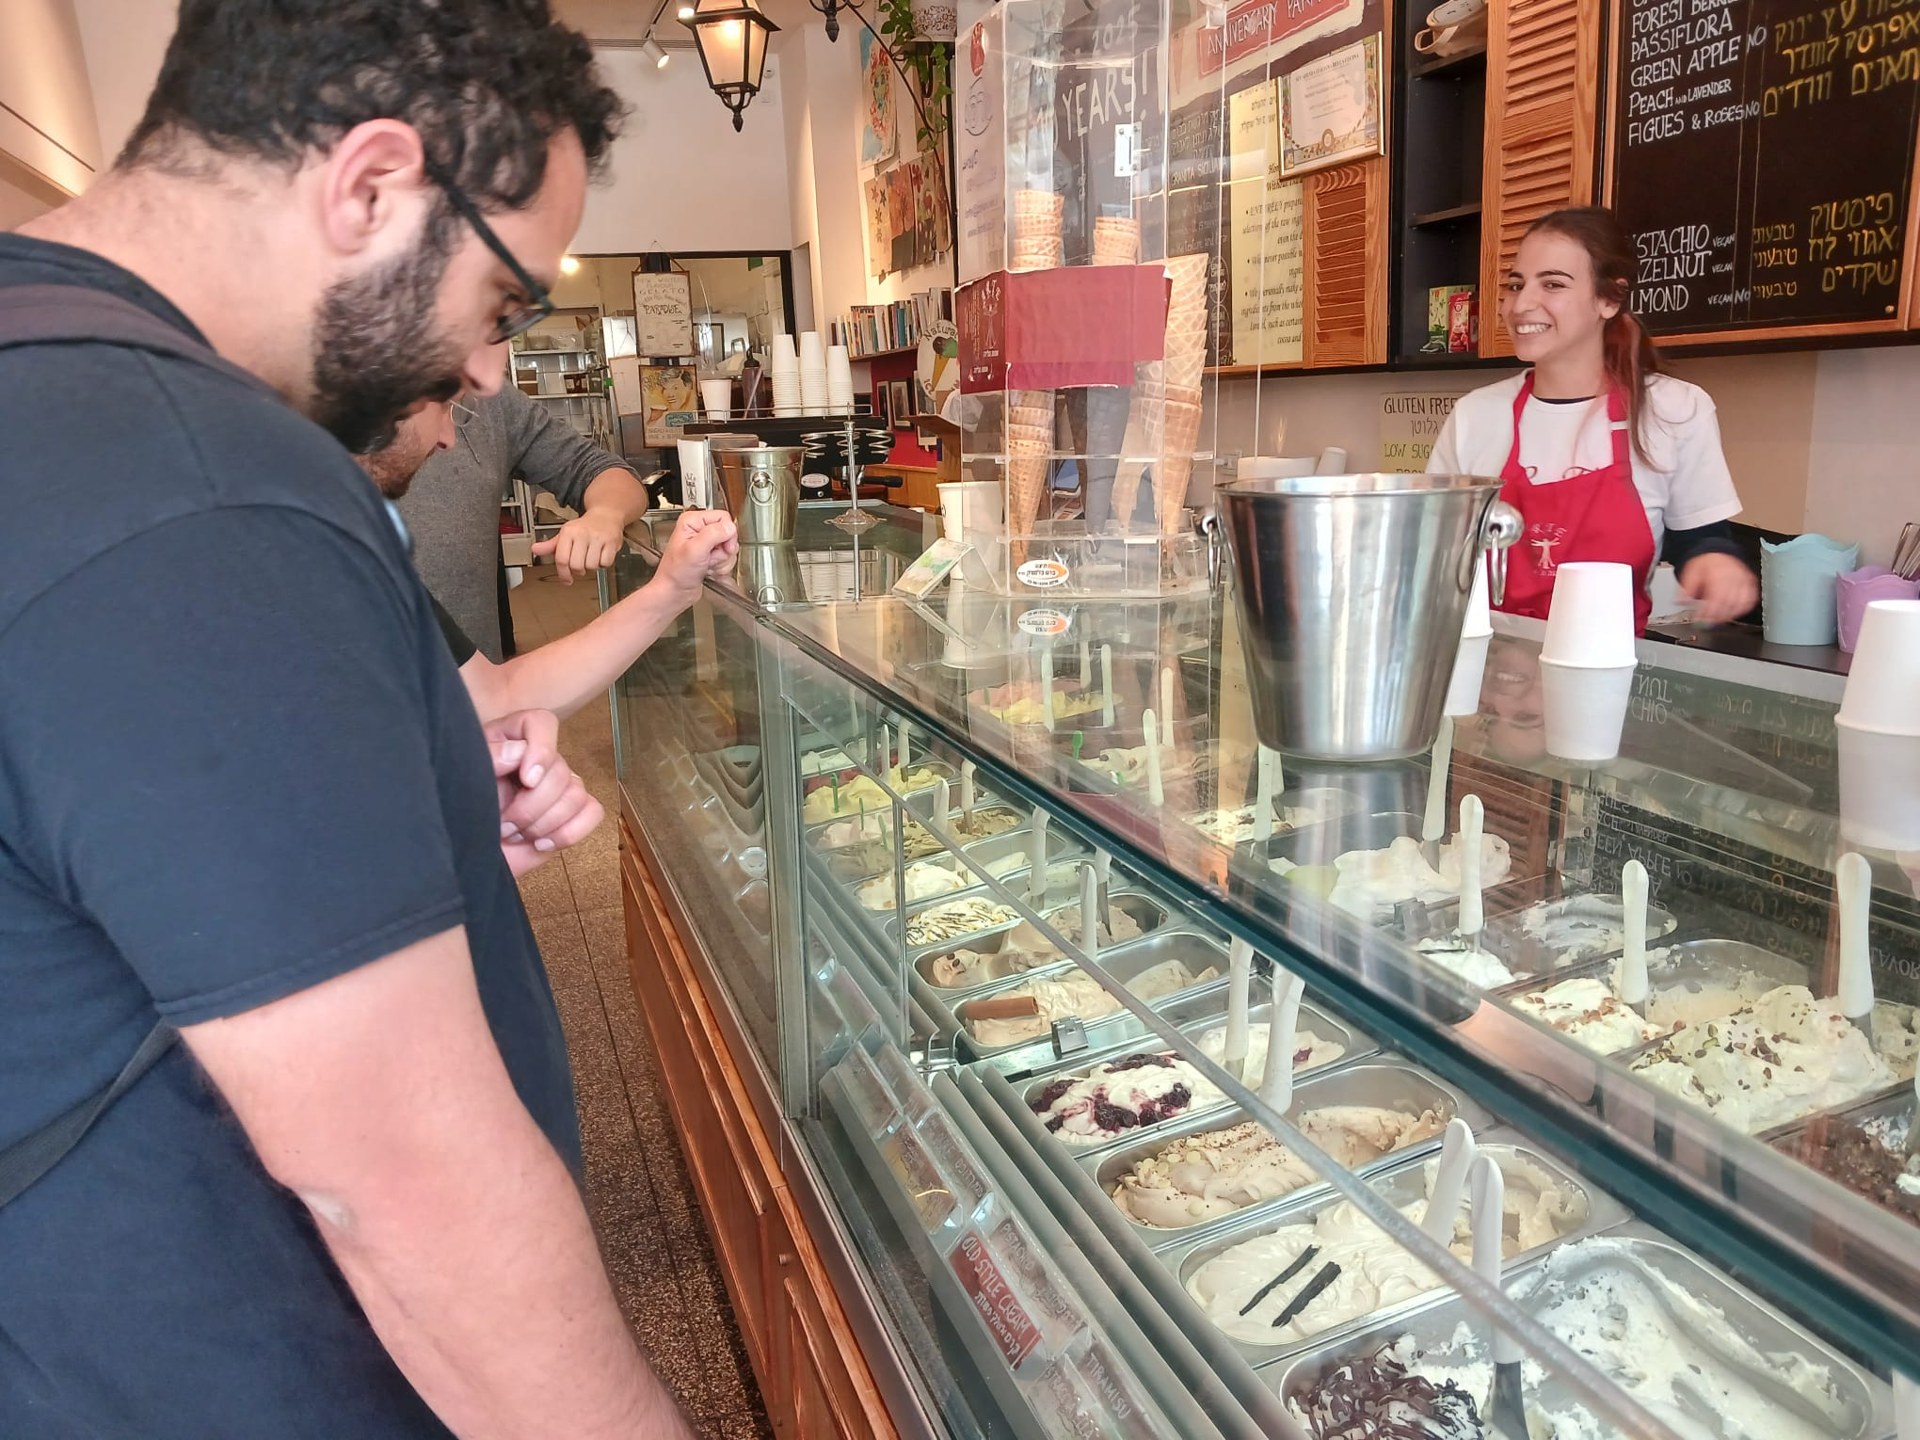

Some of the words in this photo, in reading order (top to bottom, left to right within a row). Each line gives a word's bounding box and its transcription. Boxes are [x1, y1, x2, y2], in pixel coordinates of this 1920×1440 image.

[1630, 8, 1733, 62] PASSIFLORA
[1631, 0, 1684, 39] FOREST
[1631, 54, 1681, 87] GREEN
[1687, 35, 1741, 74] APPLE
[1746, 25, 1767, 54] NO
[1851, 47, 1920, 96] תאנים
[1628, 86, 1675, 118] PEACH
[1687, 79, 1732, 102] LAVENDER
[1628, 110, 1685, 147] FIGUES
[1691, 113, 1701, 130] &
[1704, 104, 1744, 128] ROSES
[1633, 223, 1710, 259] STACHIO
[1712, 233, 1736, 248] VEGAN
[1711, 262, 1733, 274] VEGAN
[1630, 284, 1689, 315] LMOND
[1707, 293, 1733, 305] VEGAN
[1383, 397, 1427, 415] GLUTEN
[1410, 416, 1439, 437] גלוטן
[1384, 443, 1407, 458] LOW
[1411, 443, 1434, 460] SUG
[961, 1236, 982, 1262] OLD
[974, 1258, 1005, 1299] STYLE
[997, 1294, 1032, 1334] CREAM
[1085, 1352, 1132, 1419] TIRAMISU
